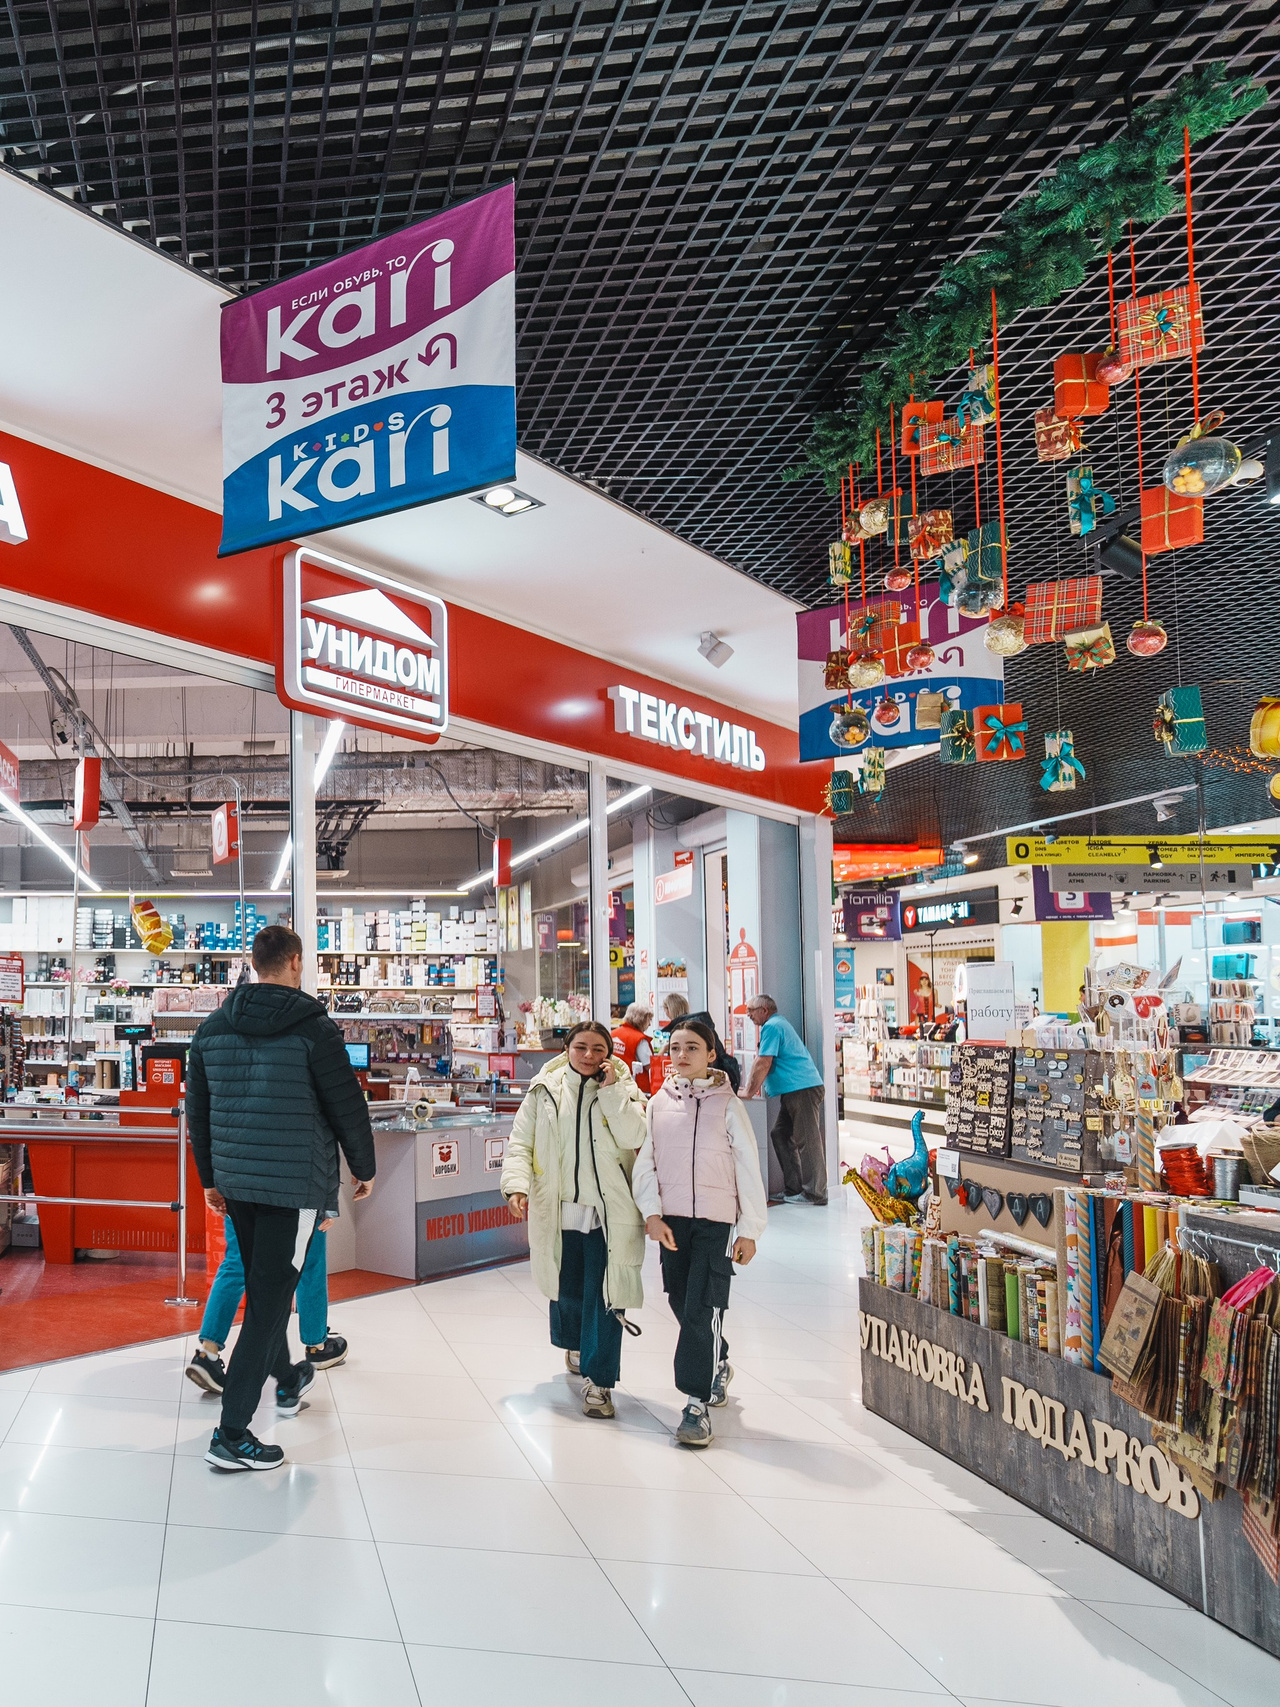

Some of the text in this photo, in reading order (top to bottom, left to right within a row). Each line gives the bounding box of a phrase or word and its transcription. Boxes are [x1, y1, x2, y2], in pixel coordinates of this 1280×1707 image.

[266, 238, 455, 374] kari
[291, 255, 407, 310] ЕСЛИ ОБУВЬ, ТО
[265, 357, 410, 430] 3 этаж
[267, 404, 453, 522] kari
[301, 616, 441, 696] УНИДОМ
[335, 675, 416, 710] ГИПЕРМАРКЕТ
[608, 685, 766, 772] ТЕКСТИЛЬ
[216, 820, 223, 848] 2
[849, 893, 894, 905] familia
[970, 1004, 1014, 1021] работу
[435, 1163, 457, 1175] КОРОБКИ
[426, 1212, 465, 1241] МЕСТО
[858, 1310, 1201, 1520] УПАКОВКА ПОДАРКОВ
